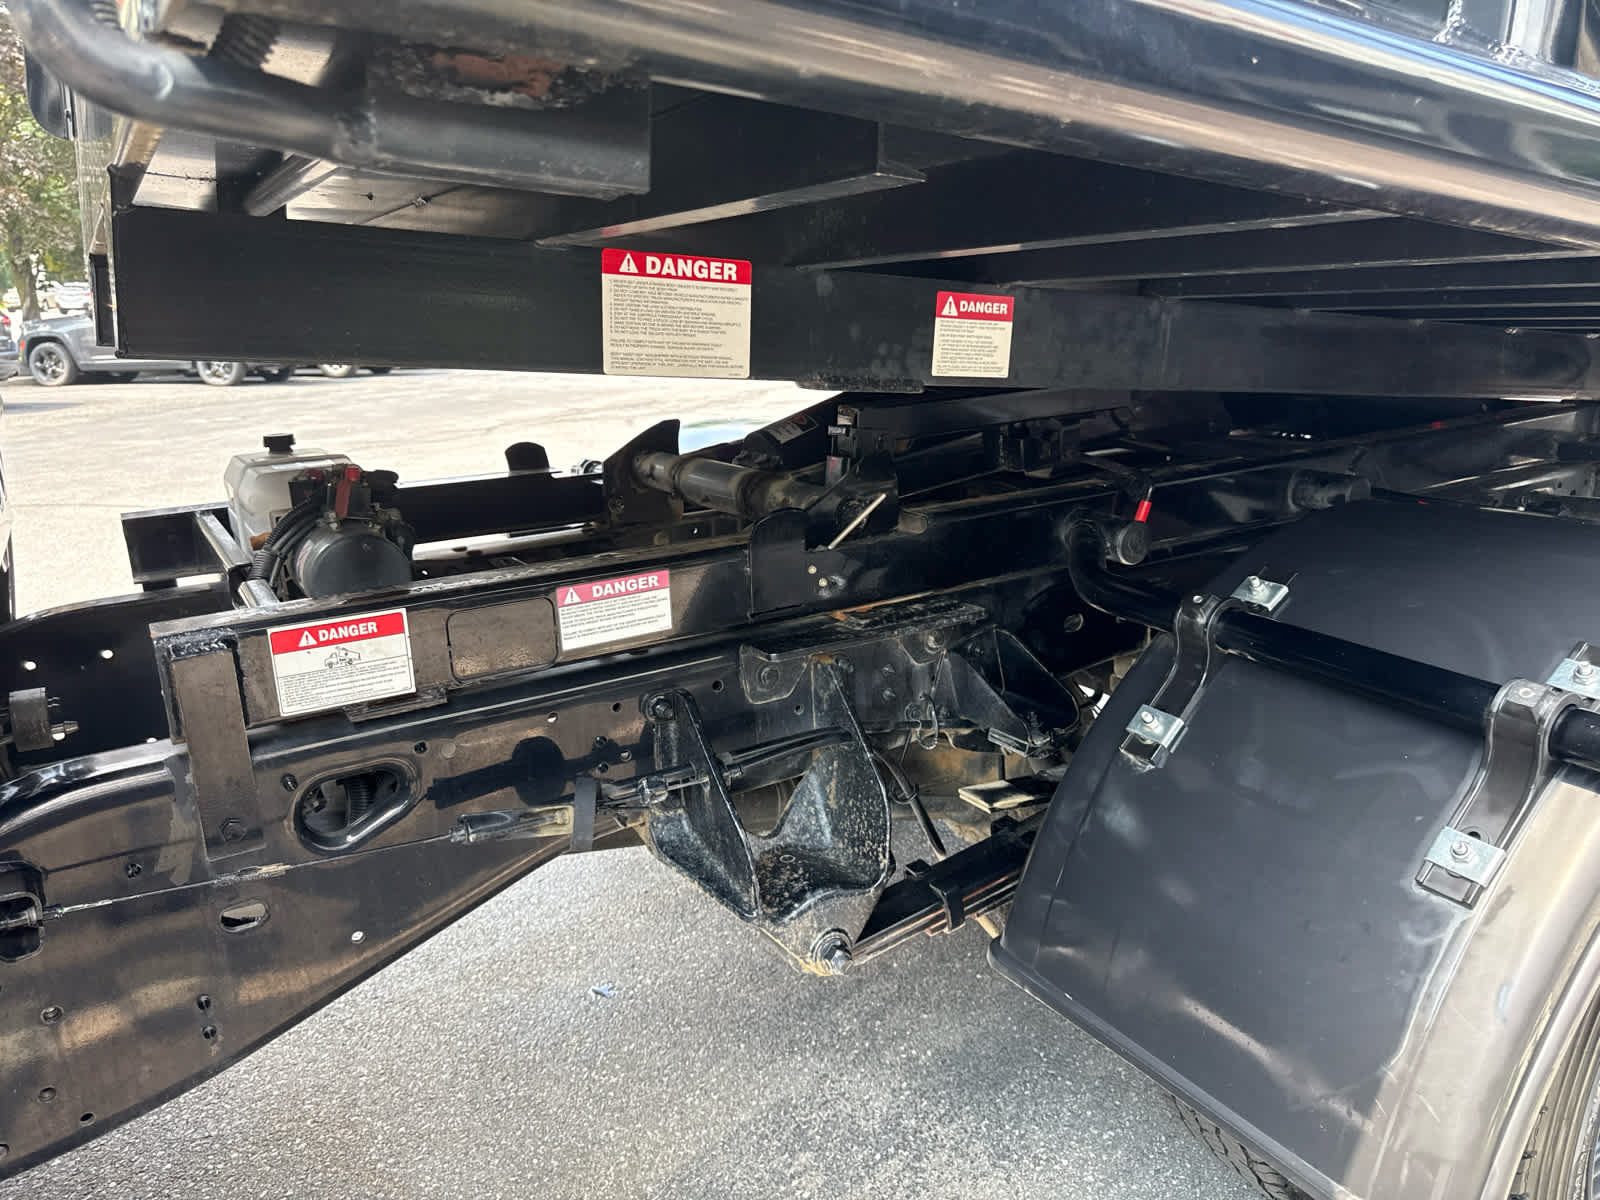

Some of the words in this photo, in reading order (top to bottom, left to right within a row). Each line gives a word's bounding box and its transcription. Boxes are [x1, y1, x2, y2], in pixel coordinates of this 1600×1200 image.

[646, 256, 737, 281] DANGER
[960, 300, 1008, 315] DANGER
[592, 575, 659, 598] DANGER
[318, 622, 378, 642] DANGER
